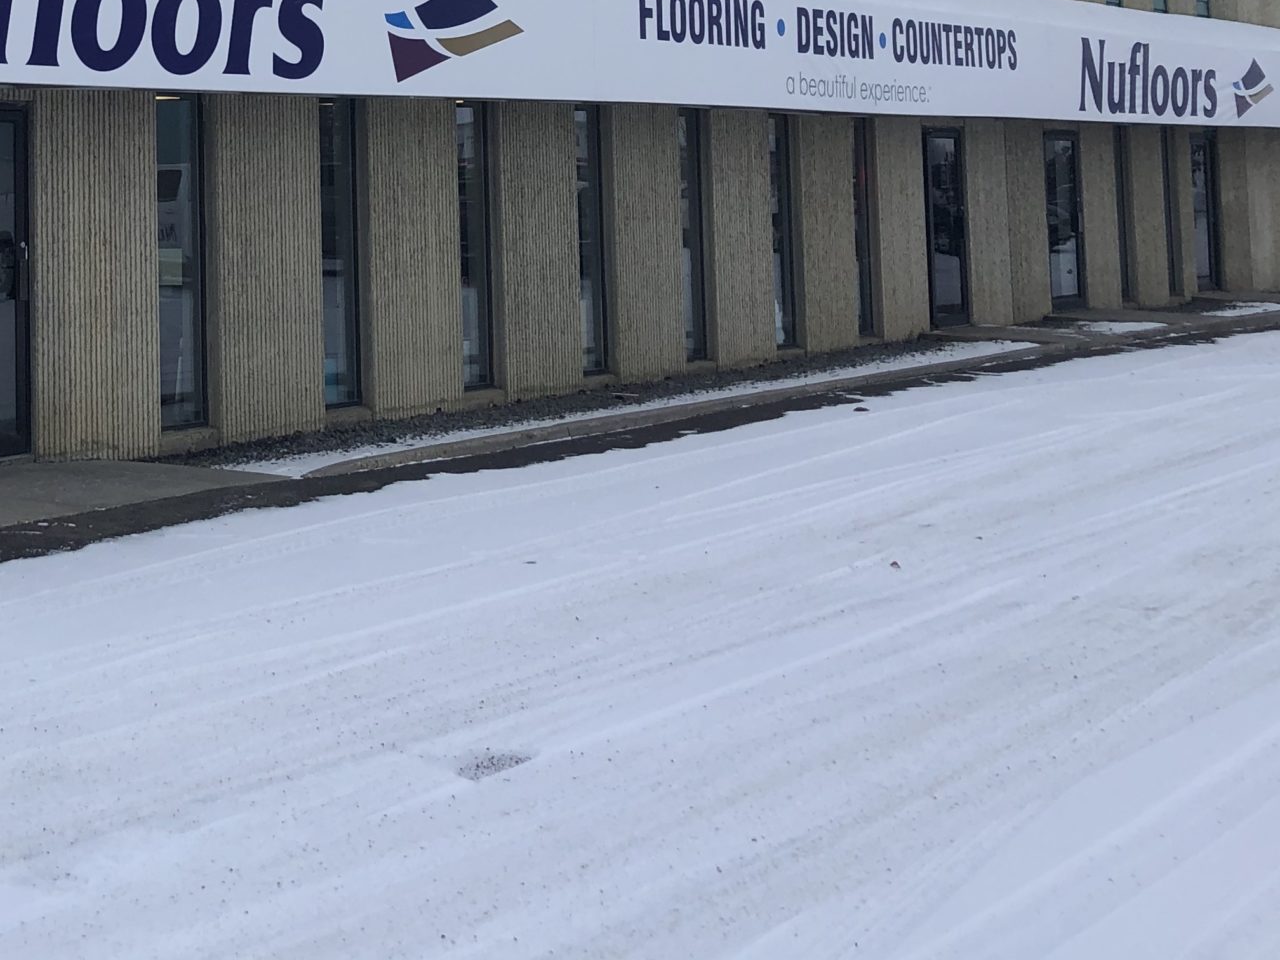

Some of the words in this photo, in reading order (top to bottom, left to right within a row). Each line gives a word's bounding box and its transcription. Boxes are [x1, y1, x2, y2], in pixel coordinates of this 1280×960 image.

[796, 6, 875, 60] DESIGN
[891, 17, 1018, 71] COUNTERTOPS
[786, 75, 795, 95] a
[799, 71, 857, 100] beautiful
[1078, 36, 1218, 119] Nufloors
